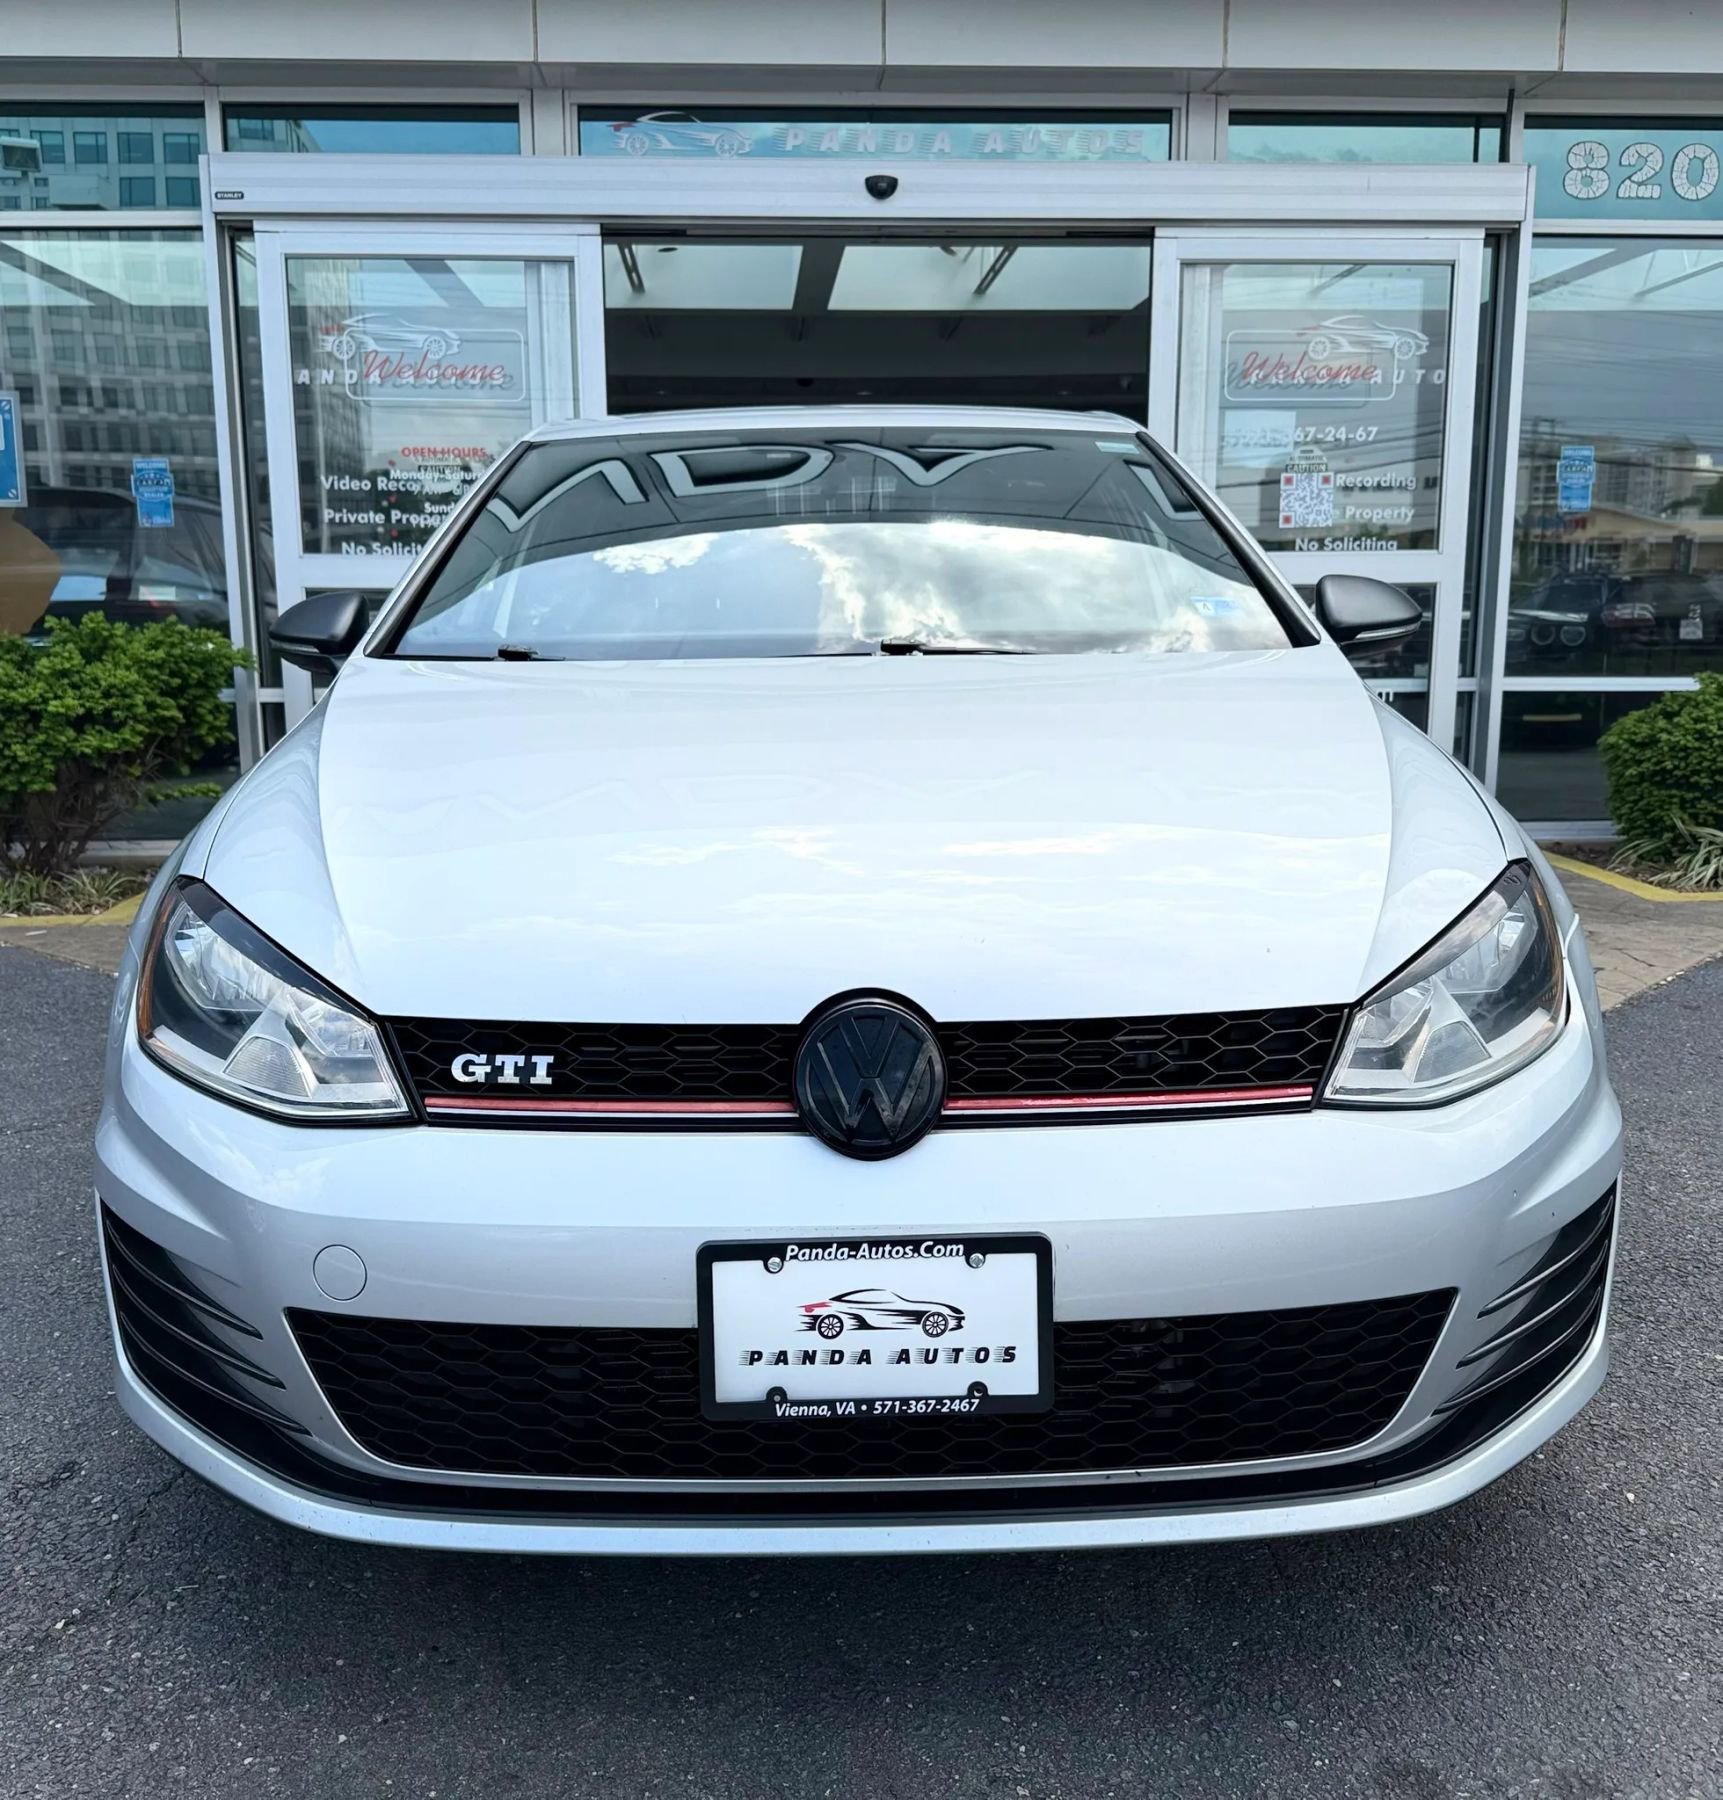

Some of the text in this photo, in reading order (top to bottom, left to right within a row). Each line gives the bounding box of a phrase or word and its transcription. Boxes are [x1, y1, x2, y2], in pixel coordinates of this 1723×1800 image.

[776, 126, 1144, 154] PANDA AUTOS
[1562, 141, 1720, 200] 820
[363, 350, 504, 381] Welcome
[1242, 351, 1377, 381] Welcome
[401, 447, 486, 458] OPEN HOURS
[1286, 464, 1326, 473] CAUTION
[320, 475, 372, 491] Video
[1336, 473, 1417, 490] Recording
[324, 509, 386, 524] Private
[1345, 507, 1415, 523] Property
[341, 542, 367, 555] No
[1295, 538, 1318, 551] No
[451, 1053, 554, 1085] GTI
[785, 1241, 964, 1262] Panda-Autos.Com
[741, 1346, 1017, 1366] PANDA AUTOS
[775, 1399, 980, 1418] Vienna, VA 571-367-2467
